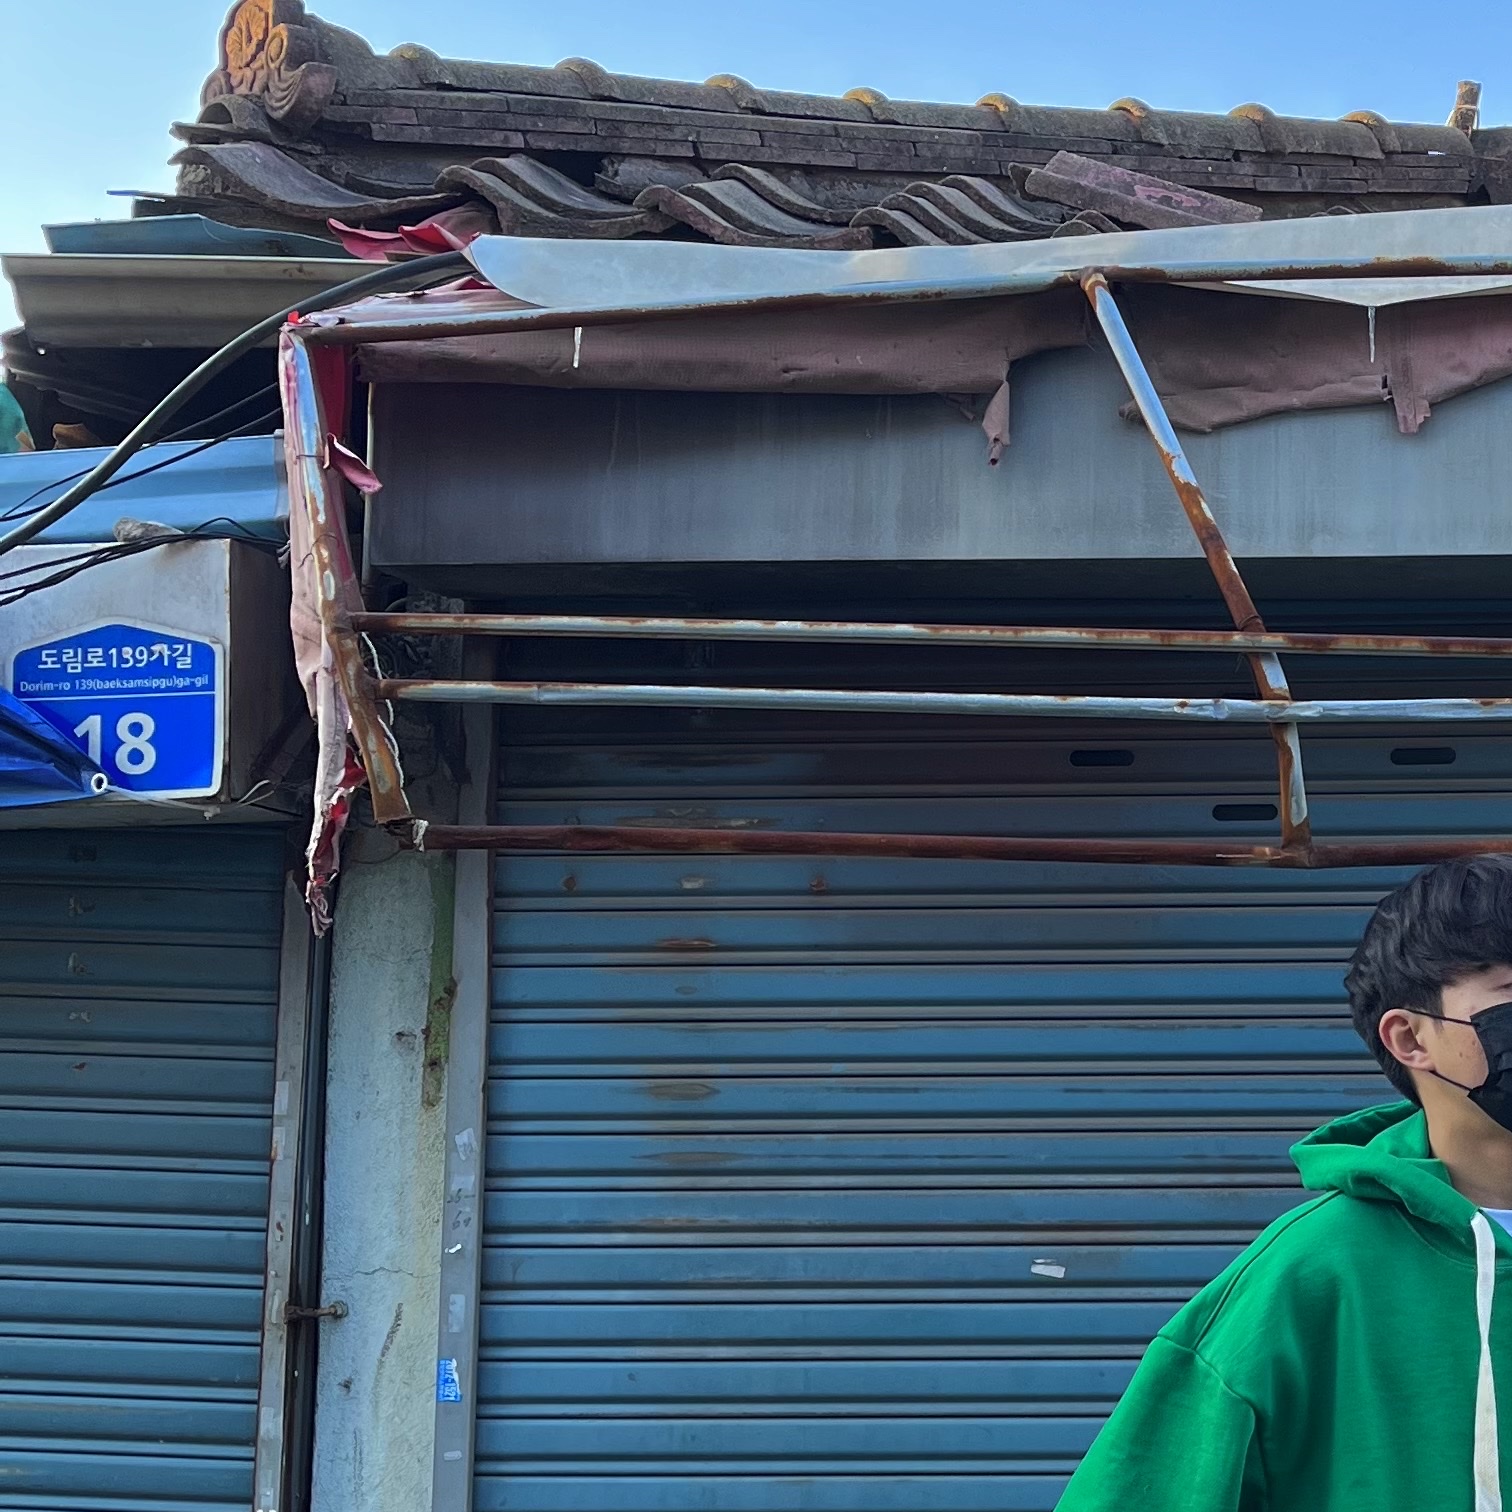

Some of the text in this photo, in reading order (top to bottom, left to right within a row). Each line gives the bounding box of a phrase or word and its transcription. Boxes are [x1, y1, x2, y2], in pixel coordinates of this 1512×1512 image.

[38, 643, 193, 673] 도림로139가길
[20, 674, 209, 692] Dorim-ro 139(baeksamsipgu)ga-gil
[73, 711, 157, 775] 18
